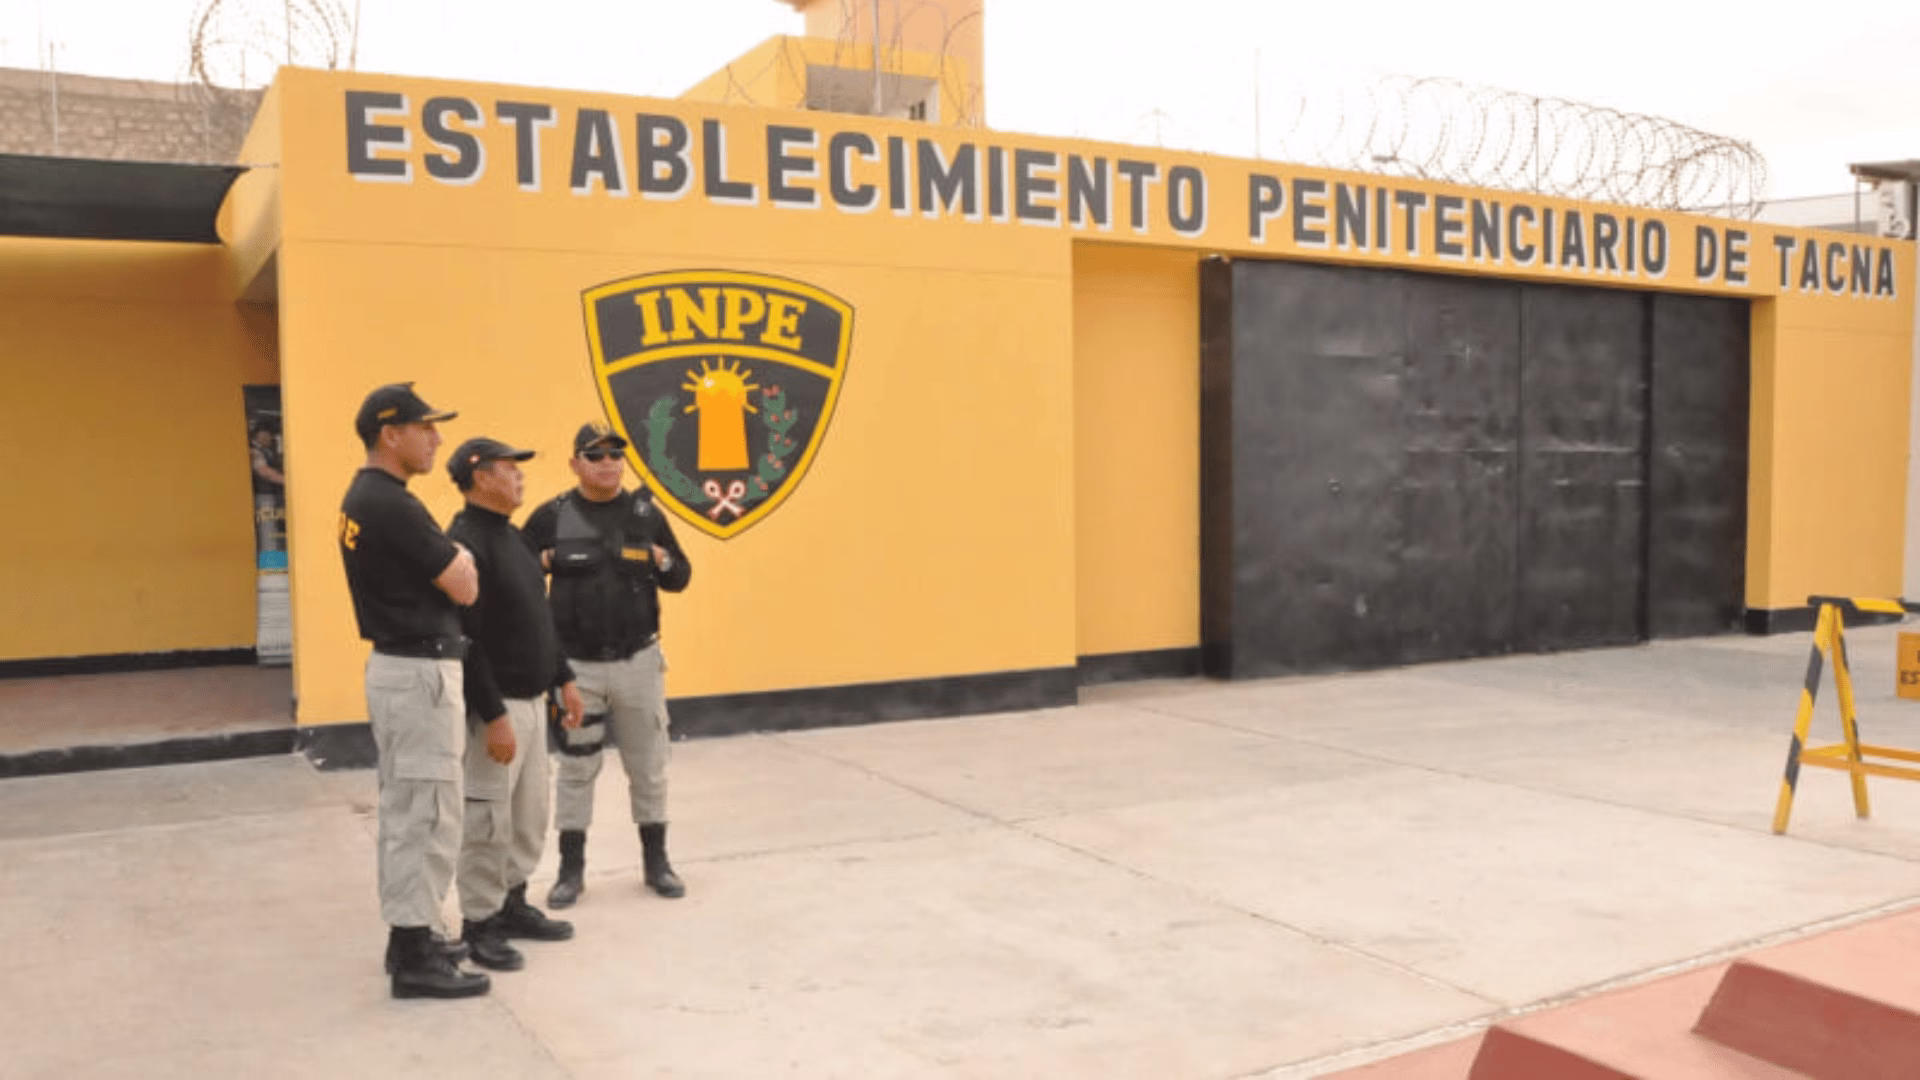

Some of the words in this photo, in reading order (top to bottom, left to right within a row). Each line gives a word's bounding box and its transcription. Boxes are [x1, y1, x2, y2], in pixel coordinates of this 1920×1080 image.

[344, 90, 1206, 238] ESTABLECIMIENTO
[1248, 173, 1667, 278] PENITENCIARIO
[1694, 225, 1749, 287] DE
[1773, 235, 1897, 299] TACNA
[634, 287, 807, 351] INPE
[1901, 671, 1920, 685] ES
